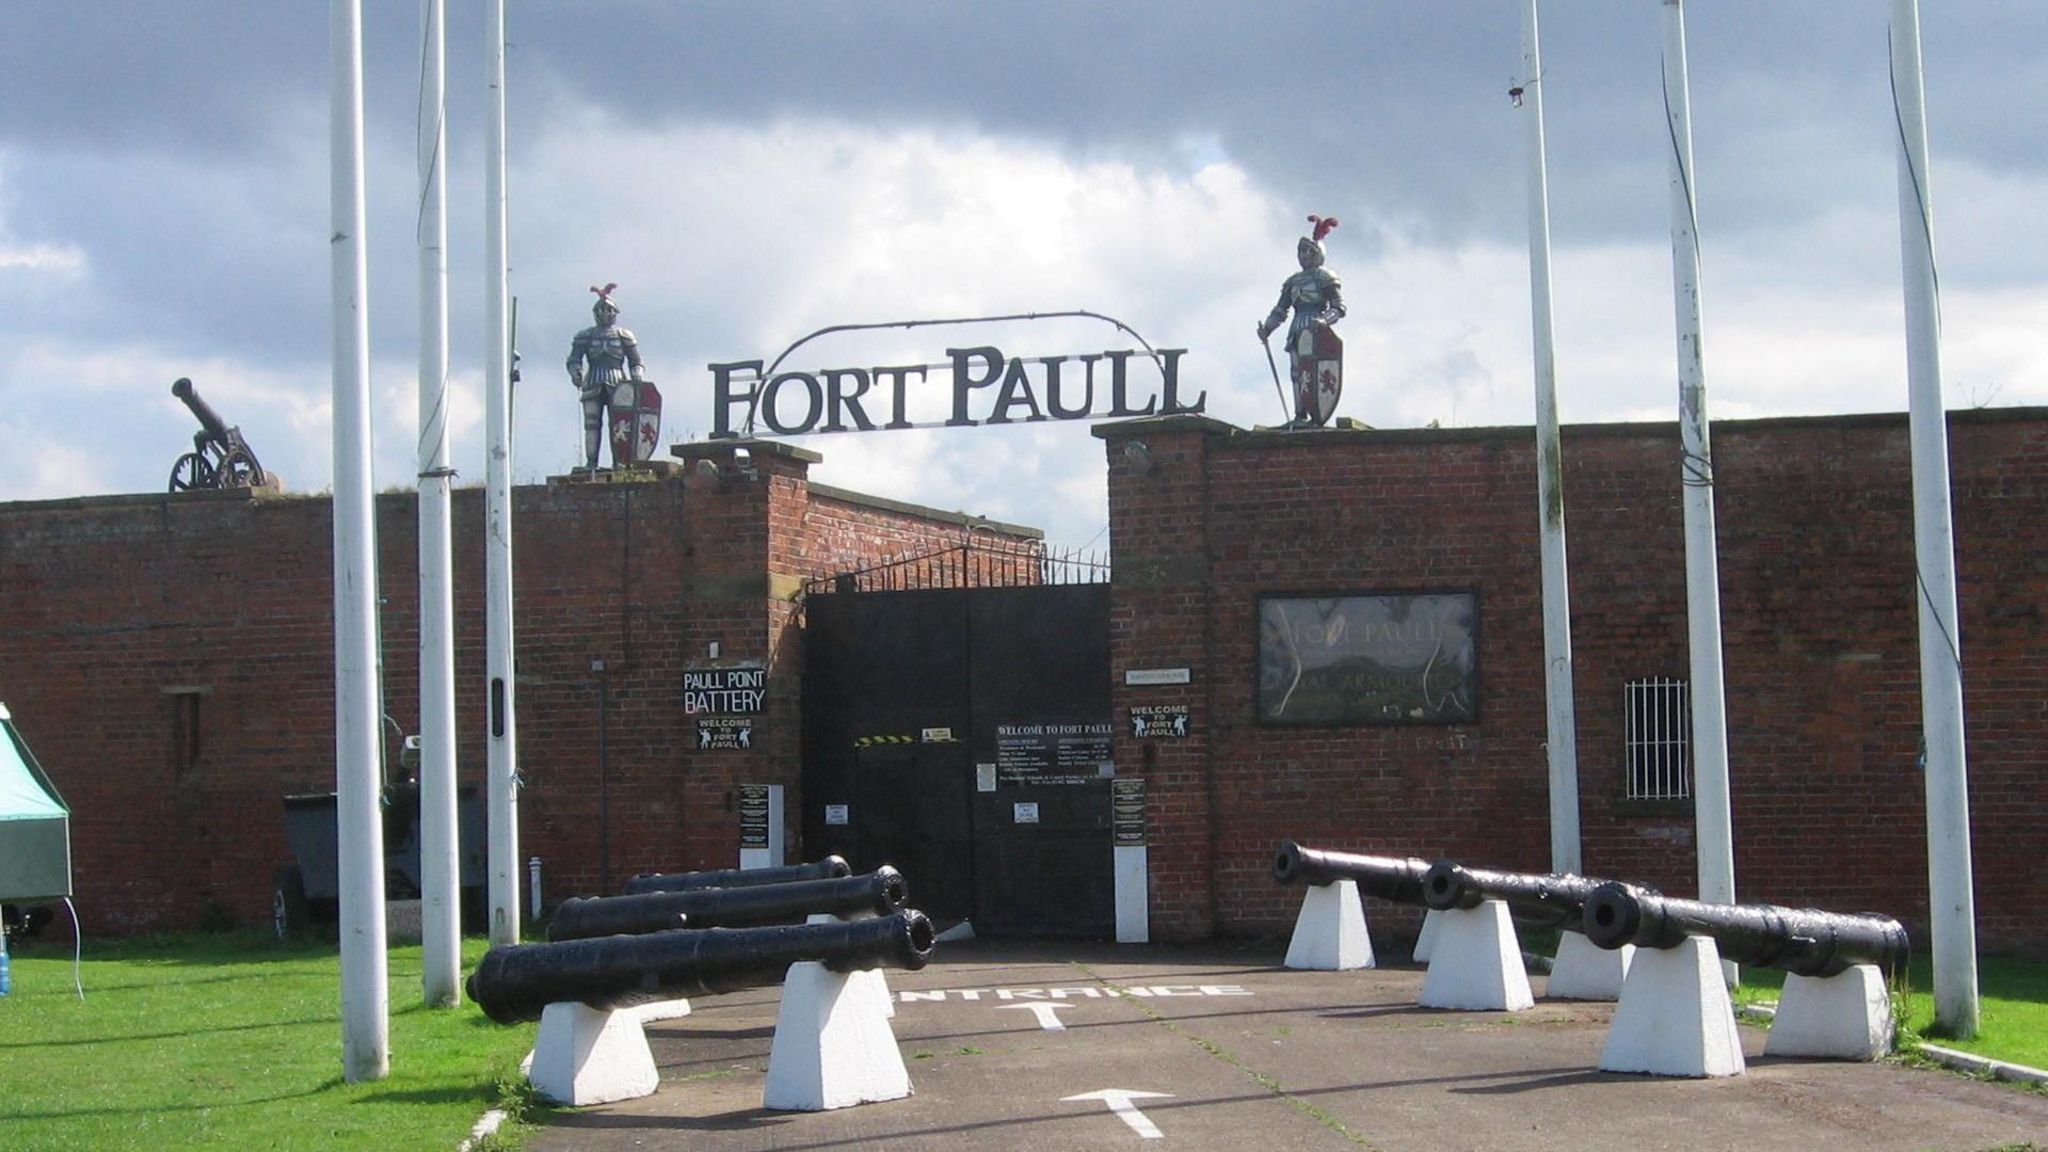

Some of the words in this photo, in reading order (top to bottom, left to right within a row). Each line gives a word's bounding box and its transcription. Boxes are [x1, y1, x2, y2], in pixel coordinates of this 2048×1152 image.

[708, 360, 927, 439] FORT
[946, 346, 1206, 426] PAULL
[684, 672, 724, 690] PAULL
[728, 670, 765, 688] POINT
[684, 689, 765, 715] BATTERY
[1130, 705, 1188, 715] WELCOME
[699, 719, 752, 728] WELCOME
[1147, 720, 1173, 729] FORT
[998, 726, 1044, 736] WELCOME
[1046, 726, 1059, 735] TO
[1059, 725, 1083, 734] FORT
[1085, 724, 1113, 734] PAULL
[1144, 728, 1176, 737] PAULL
[711, 741, 740, 749] PAULL
[892, 984, 1254, 1001] NTRANCE
